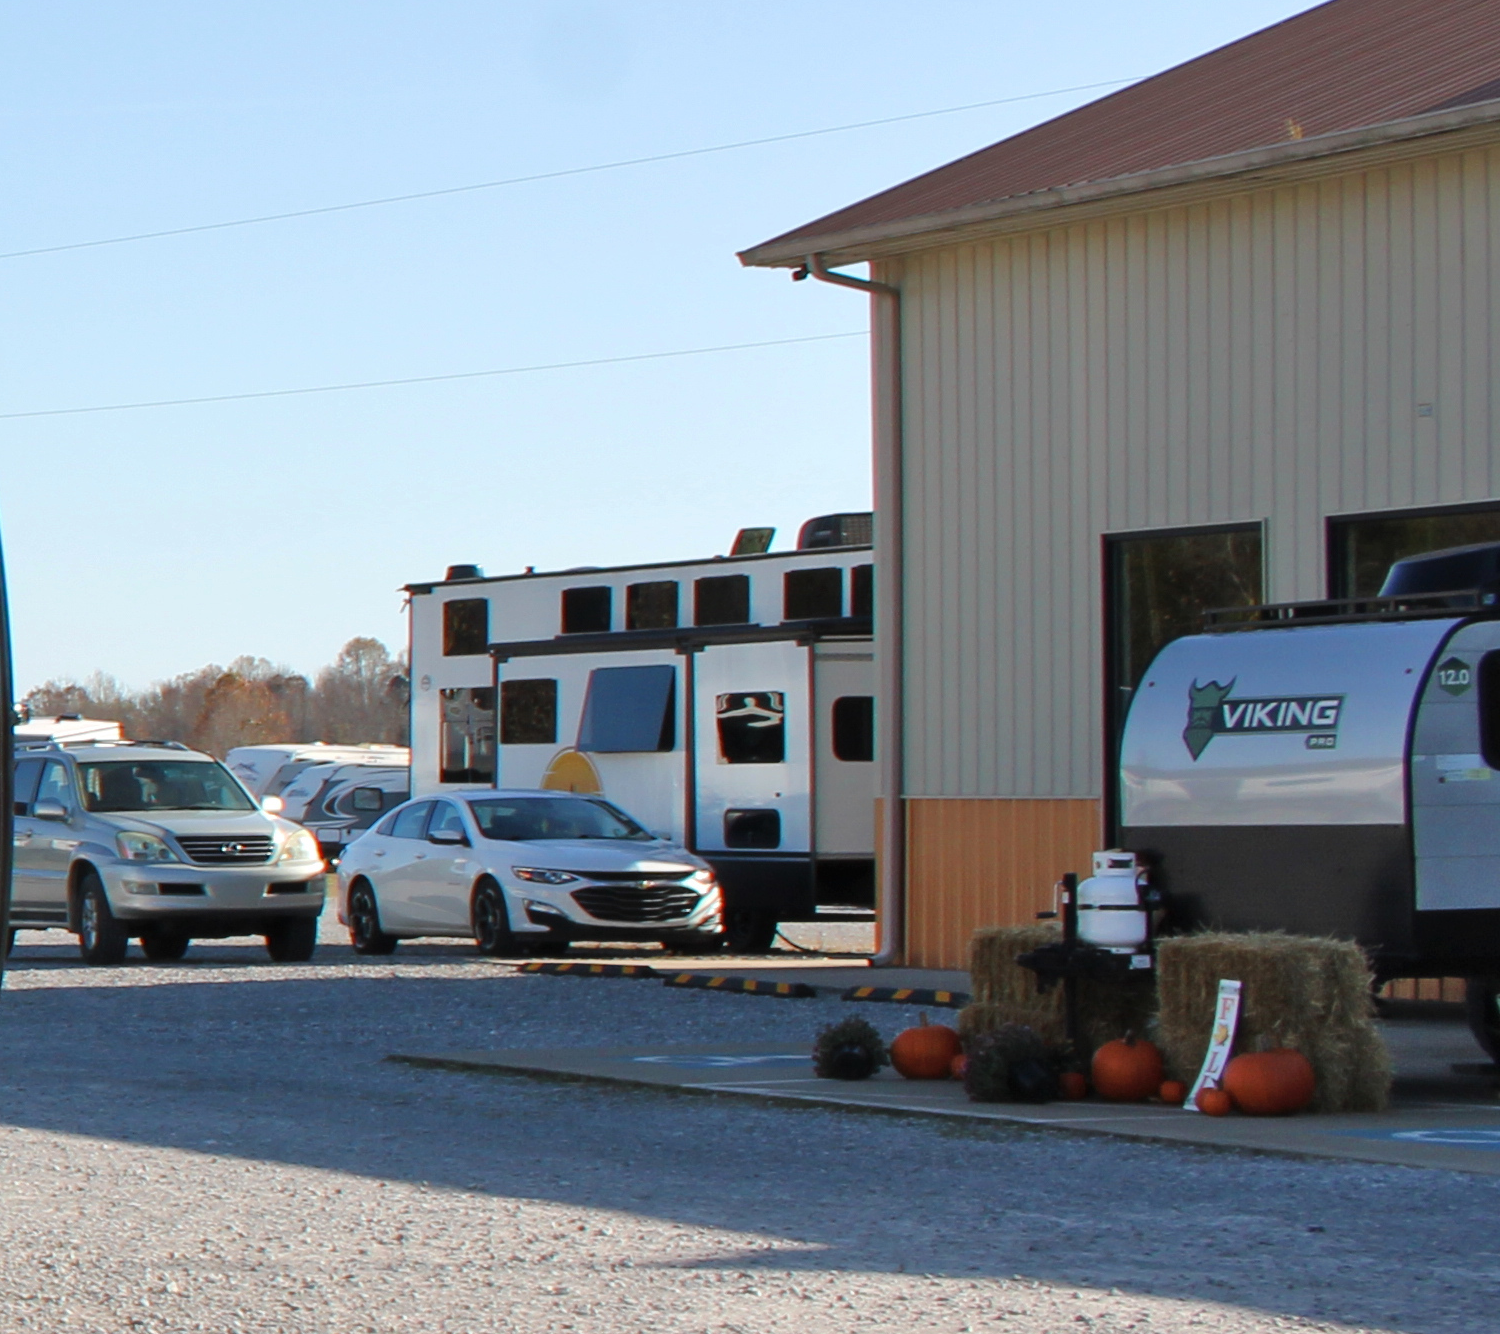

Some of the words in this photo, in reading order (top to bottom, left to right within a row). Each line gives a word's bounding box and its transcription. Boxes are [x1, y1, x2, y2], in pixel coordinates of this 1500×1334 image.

[1439, 669, 1470, 685] 12.0
[1223, 700, 1340, 729] VIKING
[1309, 736, 1335, 747] PRO
